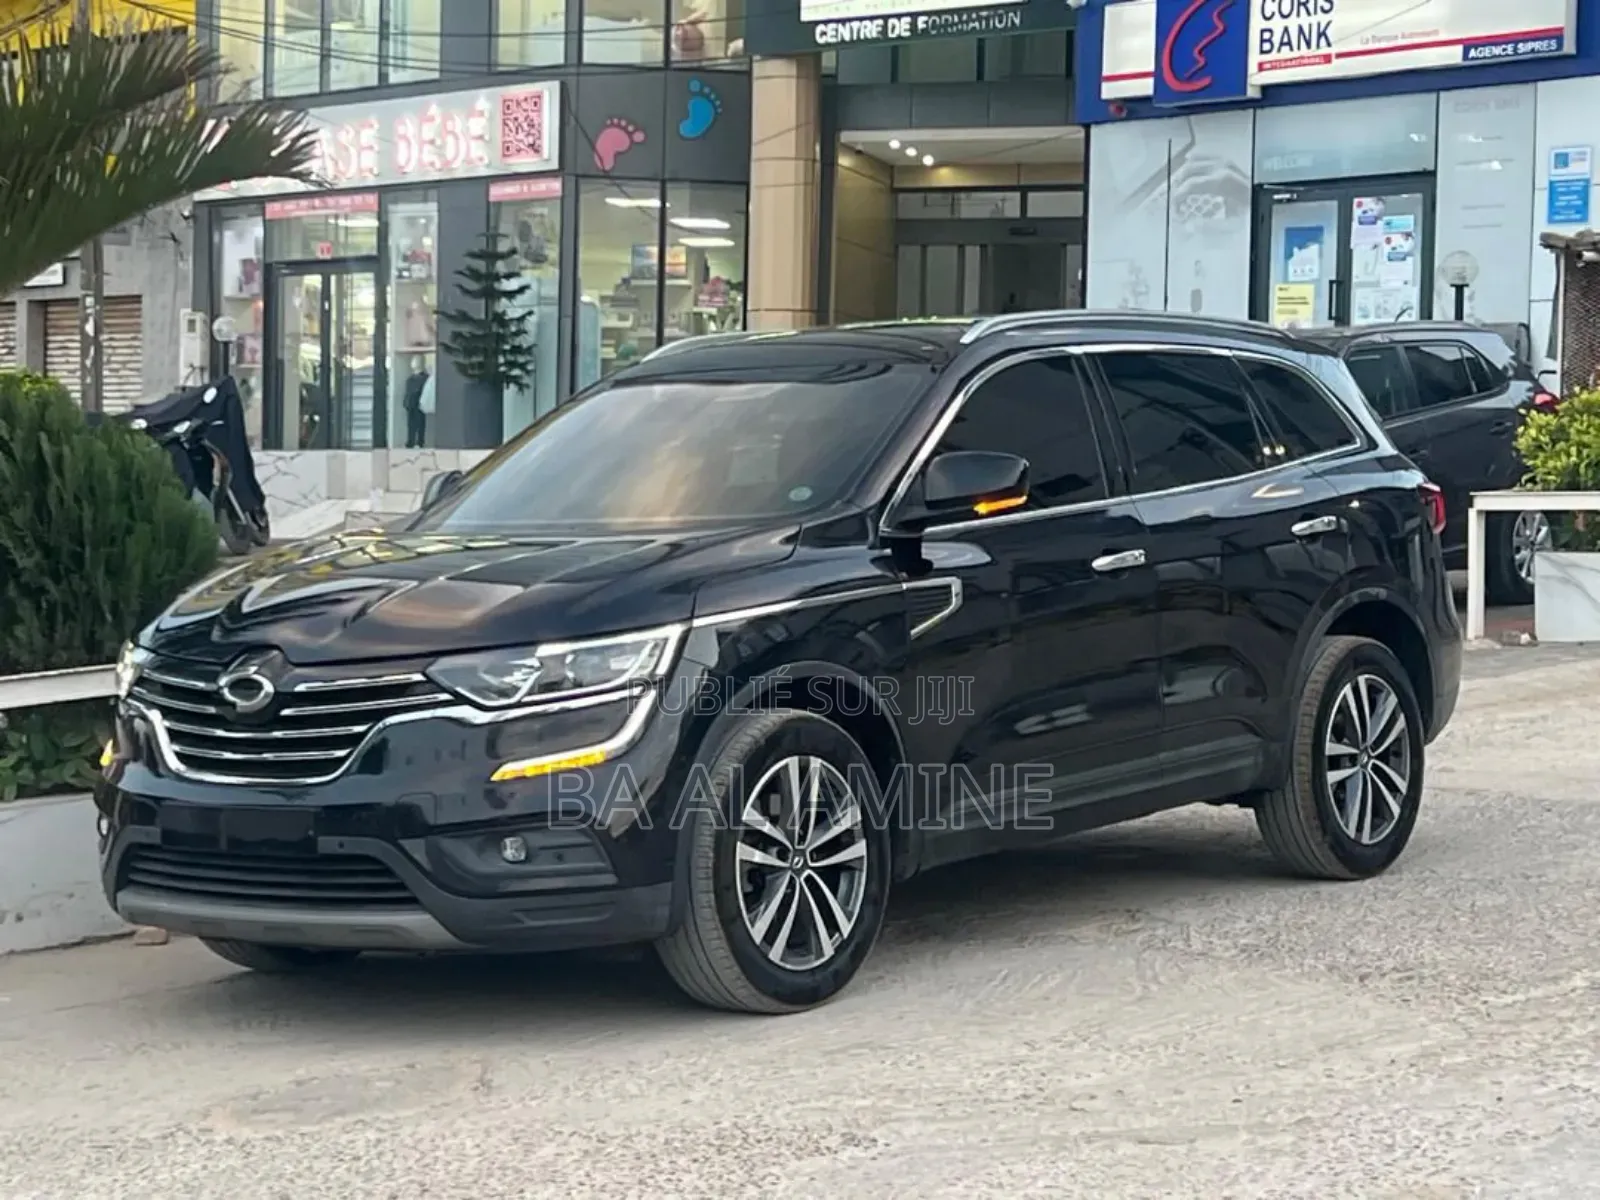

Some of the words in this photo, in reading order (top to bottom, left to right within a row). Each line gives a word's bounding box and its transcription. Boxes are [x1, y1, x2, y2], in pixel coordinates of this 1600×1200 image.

[815, 20, 883, 44] CENTRE
[887, 16, 912, 38] DE
[917, 10, 1021, 34] FORMATION
[1259, 20, 1333, 55] BANK
[1468, 44, 1515, 58] AGENCE
[395, 97, 490, 175] BÉBÉ
